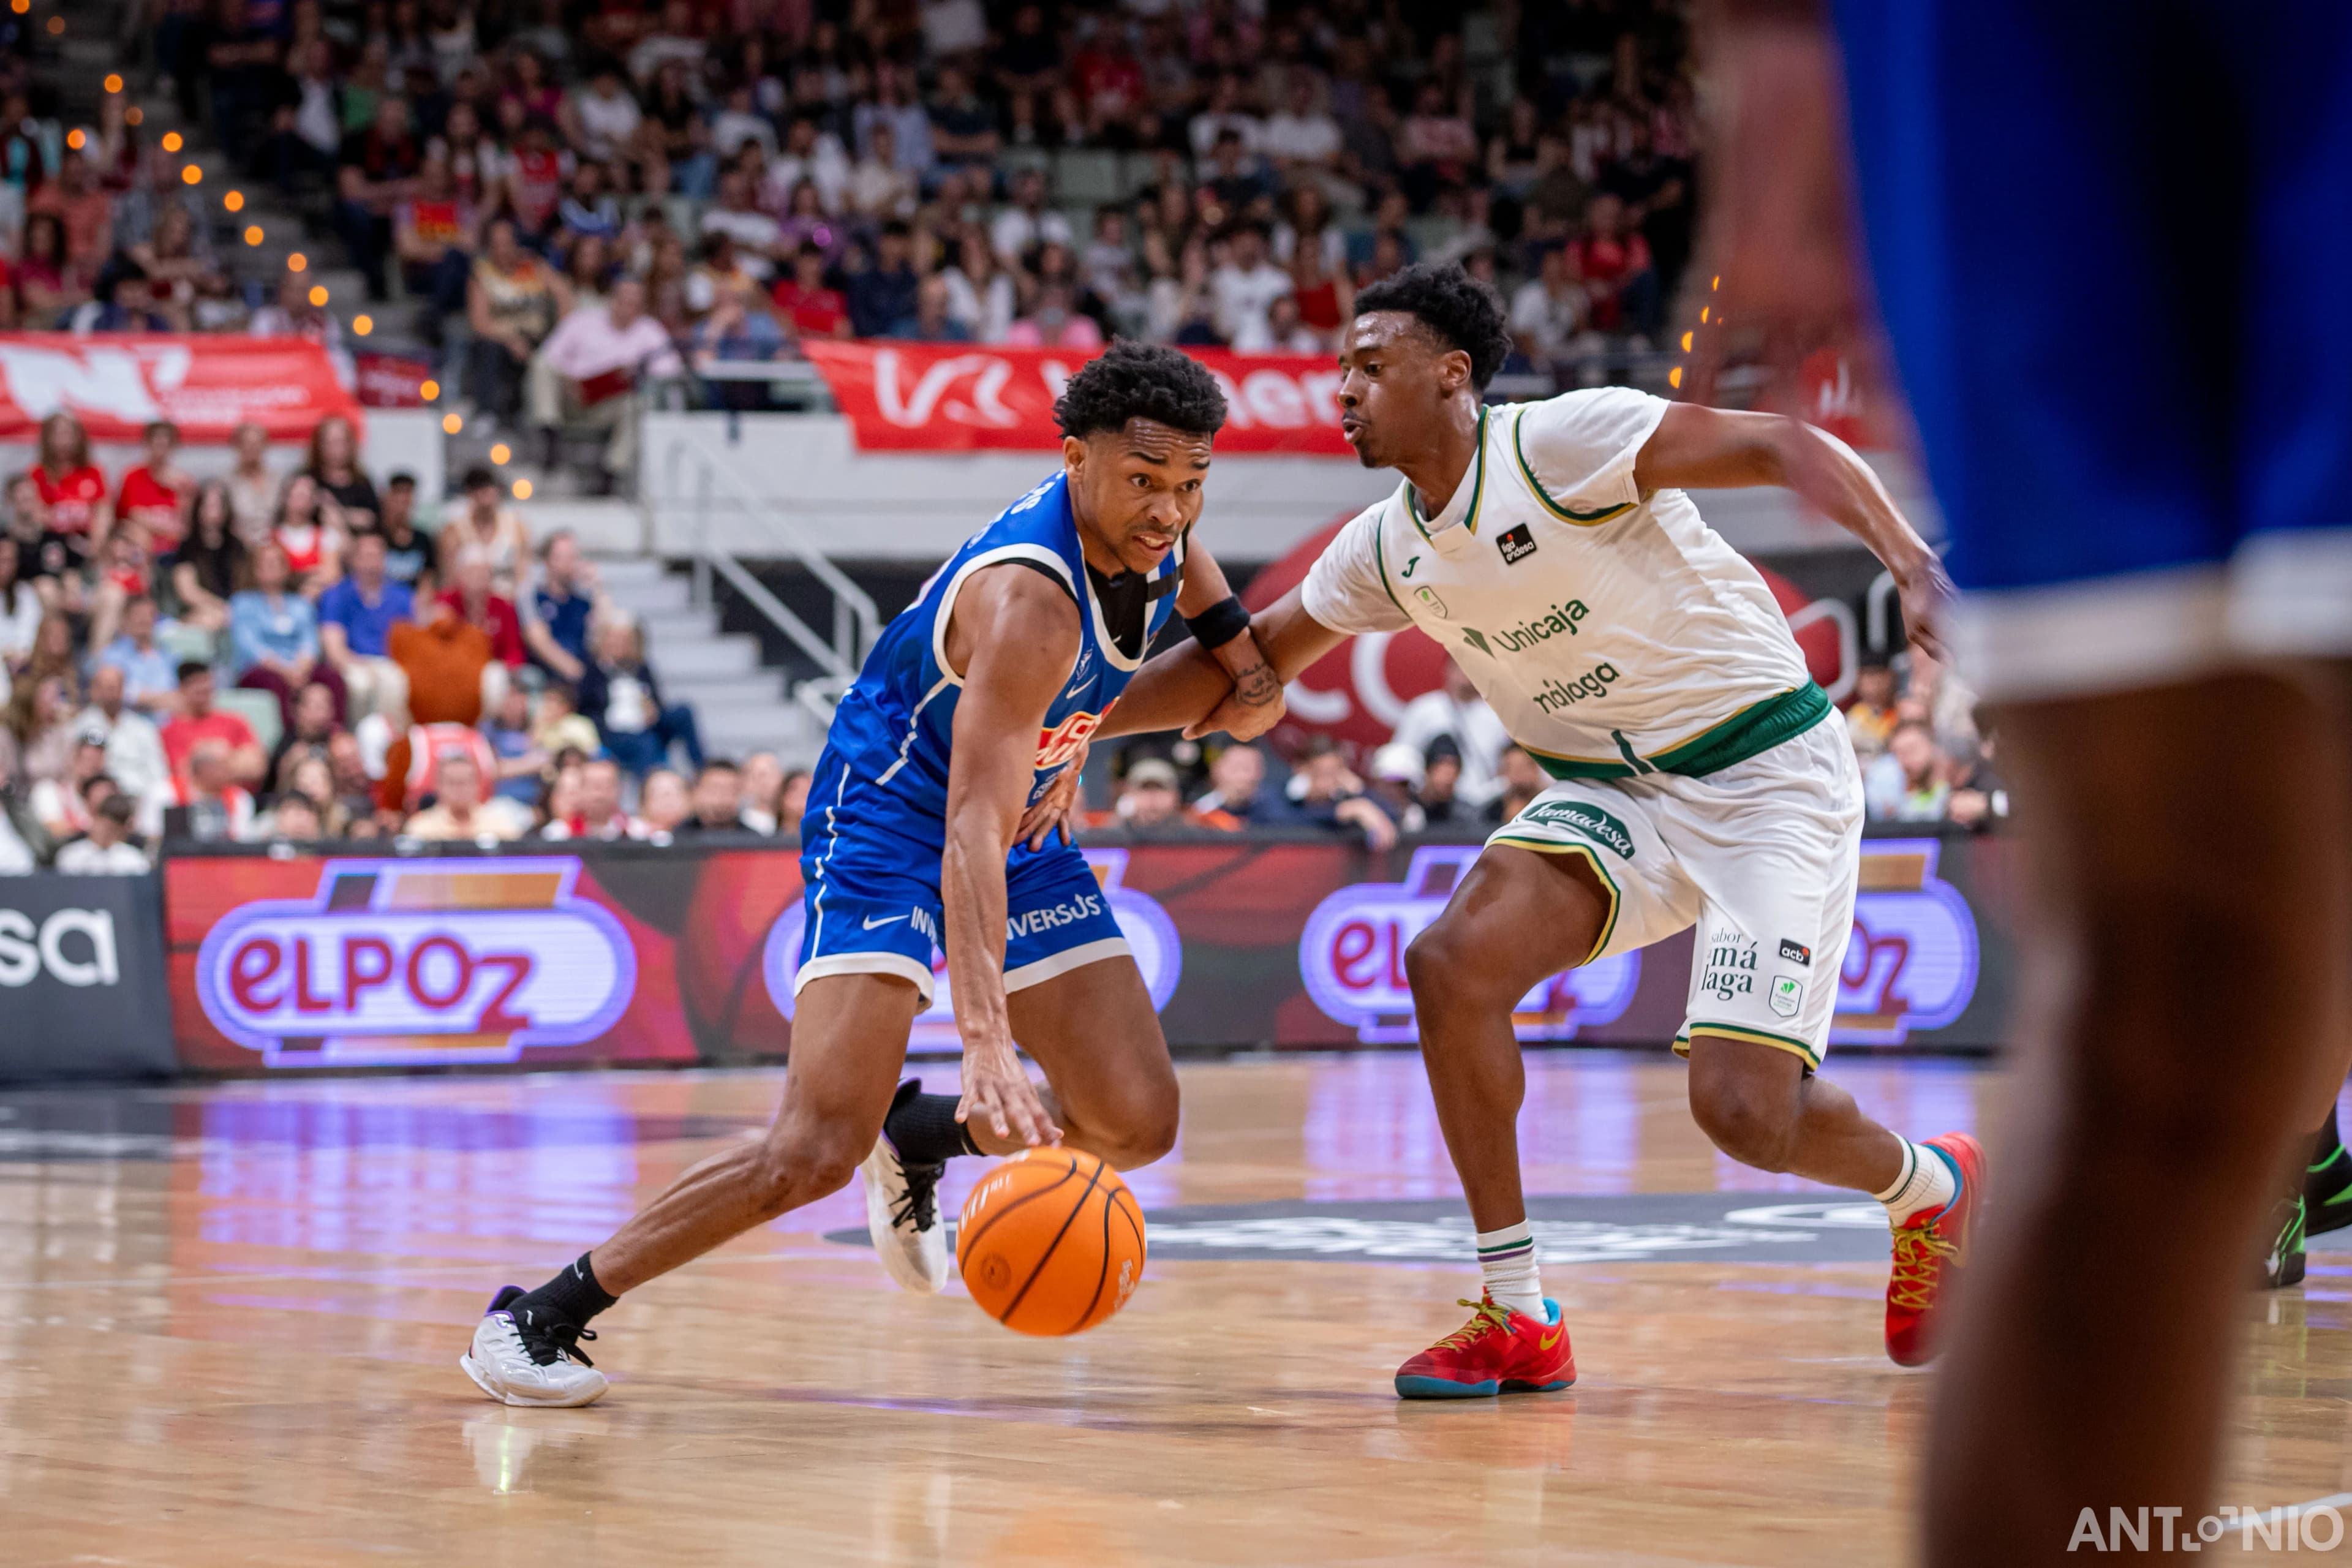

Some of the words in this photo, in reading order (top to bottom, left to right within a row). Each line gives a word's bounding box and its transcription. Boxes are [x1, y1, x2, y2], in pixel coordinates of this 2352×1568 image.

[1506, 541, 1534, 562] endesa
[1491, 599, 1590, 652] Unicaja
[1711, 927, 1744, 943] abor
[1711, 941, 1758, 970] má
[1781, 946, 1804, 963] acb
[1701, 963, 1754, 1001] laga
